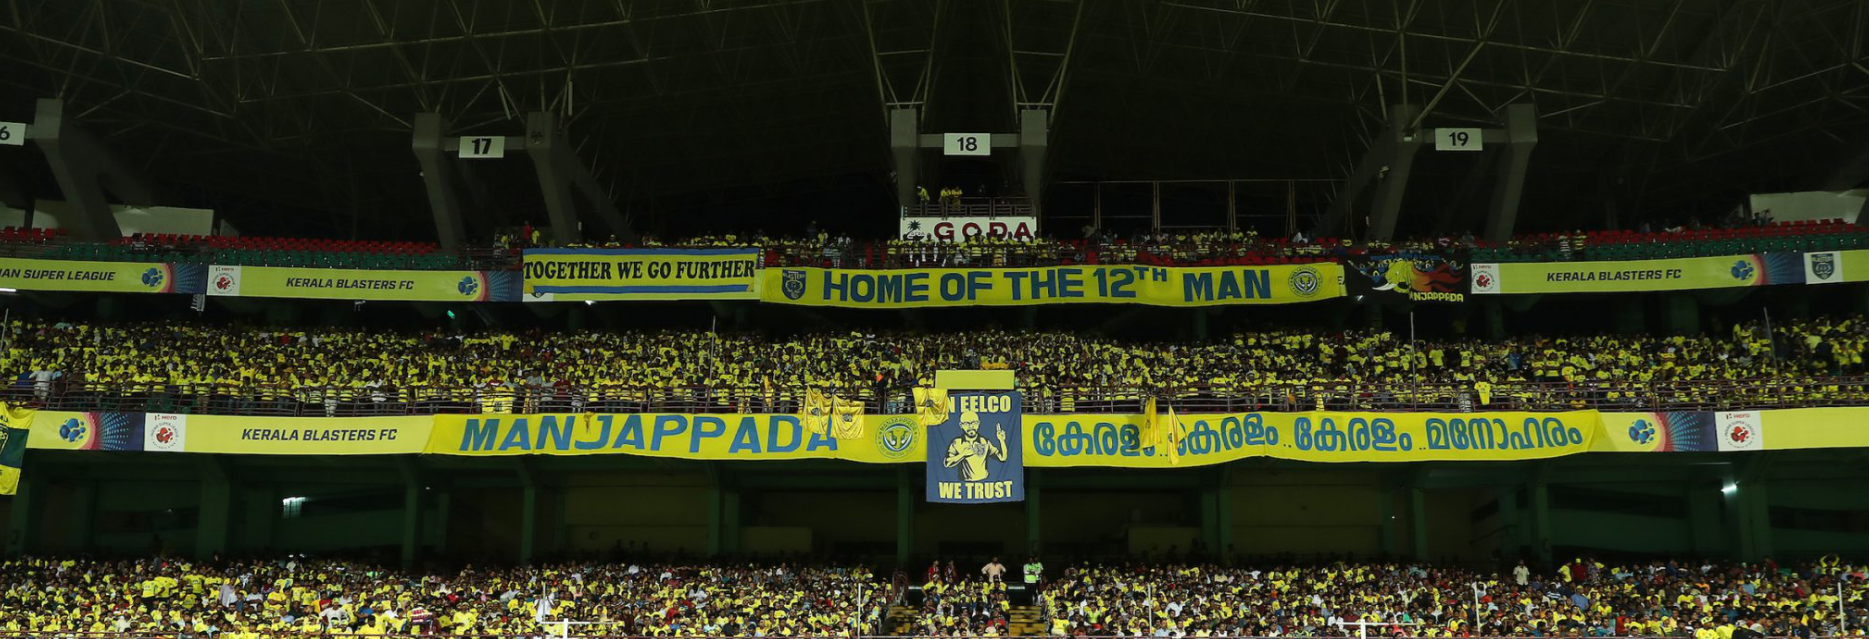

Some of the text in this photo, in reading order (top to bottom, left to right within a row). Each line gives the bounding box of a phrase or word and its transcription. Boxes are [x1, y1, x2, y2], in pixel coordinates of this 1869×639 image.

[472, 138, 492, 154] 17
[957, 136, 978, 152] 18
[1449, 132, 1469, 147] 19
[23, 269, 65, 280] SUPER
[67, 270, 116, 281] LEAGUE
[522, 260, 755, 280] TOGETHER WE GO FURTHER
[1547, 268, 1682, 282] KERALA BLASTERS FC
[286, 277, 415, 290] KERALA BLASTERS FC
[823, 270, 929, 303] HOME
[940, 270, 993, 301] OF
[1004, 268, 1084, 301] THE
[1092, 265, 1167, 299] 12TH
[1182, 269, 1271, 303] MAN
[960, 395, 1011, 413] EELCO
[242, 428, 398, 441] KERALA BLASTERS FC
[459, 414, 838, 453] MANJAPPADA
[938, 481, 1013, 499] WE TRUST
